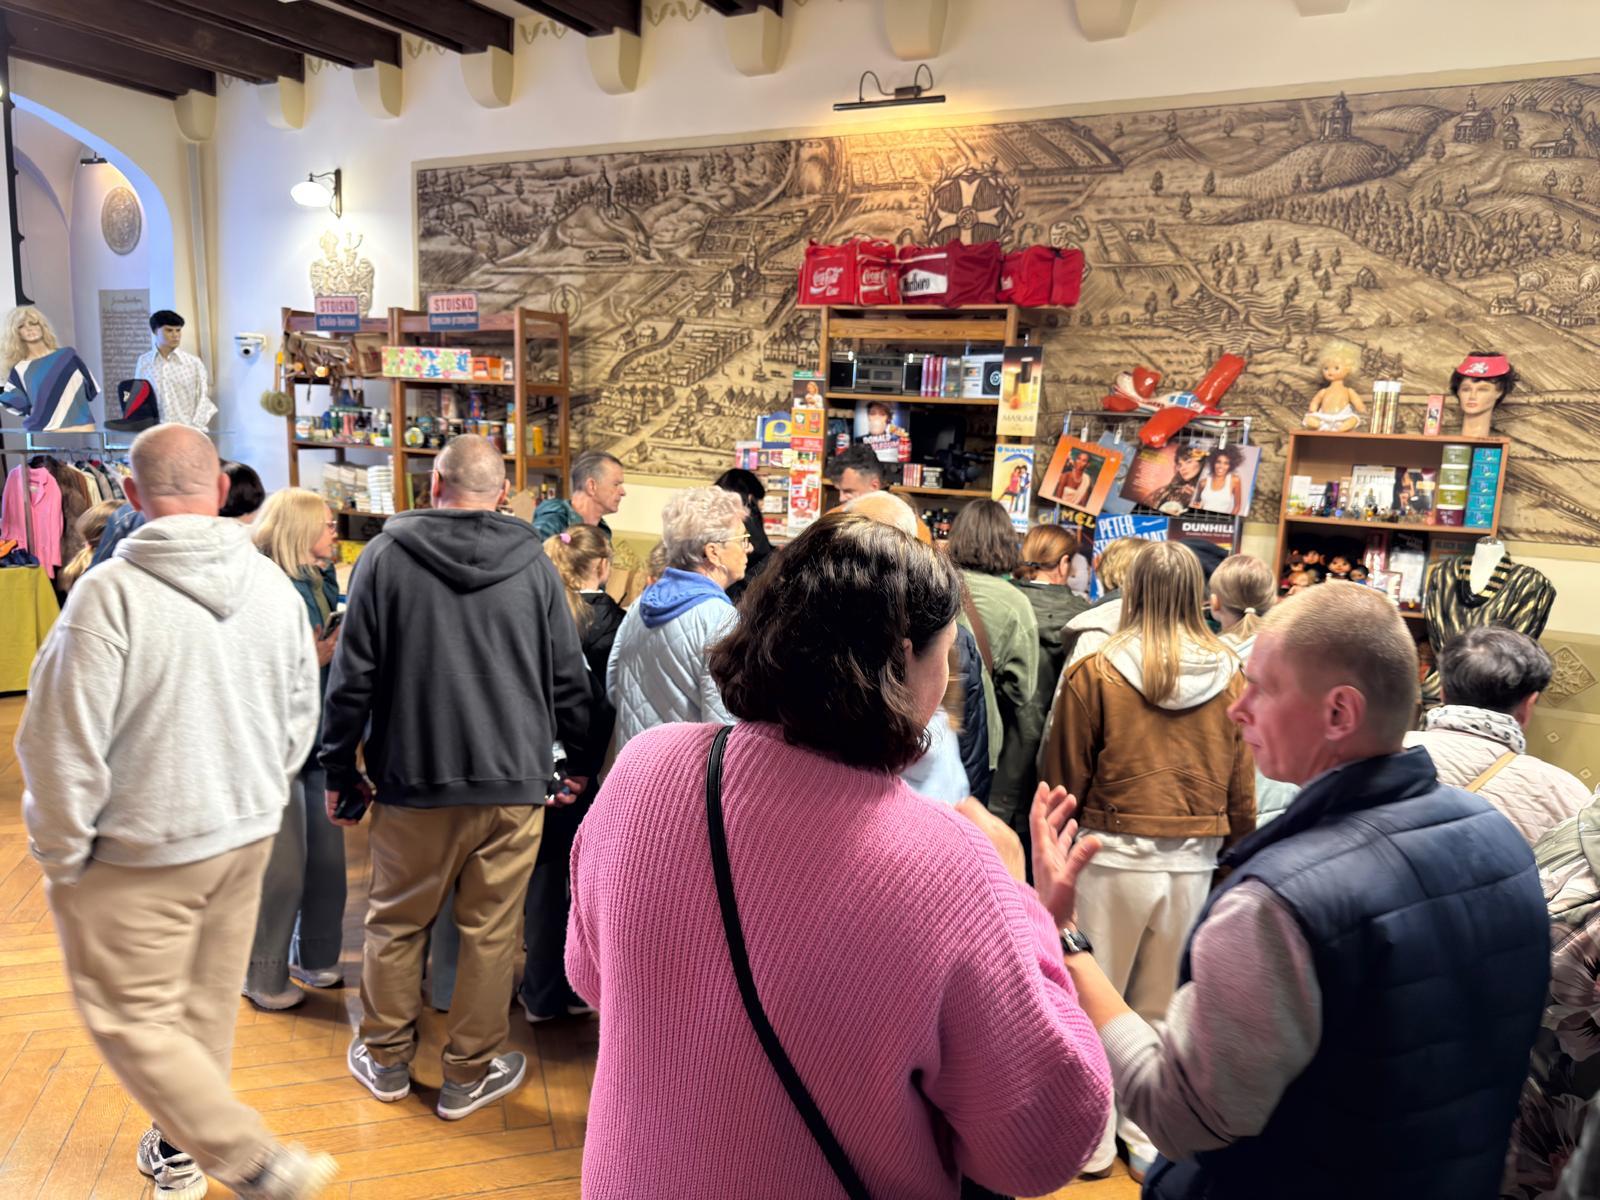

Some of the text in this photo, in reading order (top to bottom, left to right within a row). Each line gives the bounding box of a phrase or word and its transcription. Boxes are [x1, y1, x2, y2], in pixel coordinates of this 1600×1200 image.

[319, 301, 356, 313] STOISKO
[433, 299, 474, 312] STOISKO
[1098, 515, 1136, 540] PETER
[1182, 522, 1234, 534] DUNHILL
